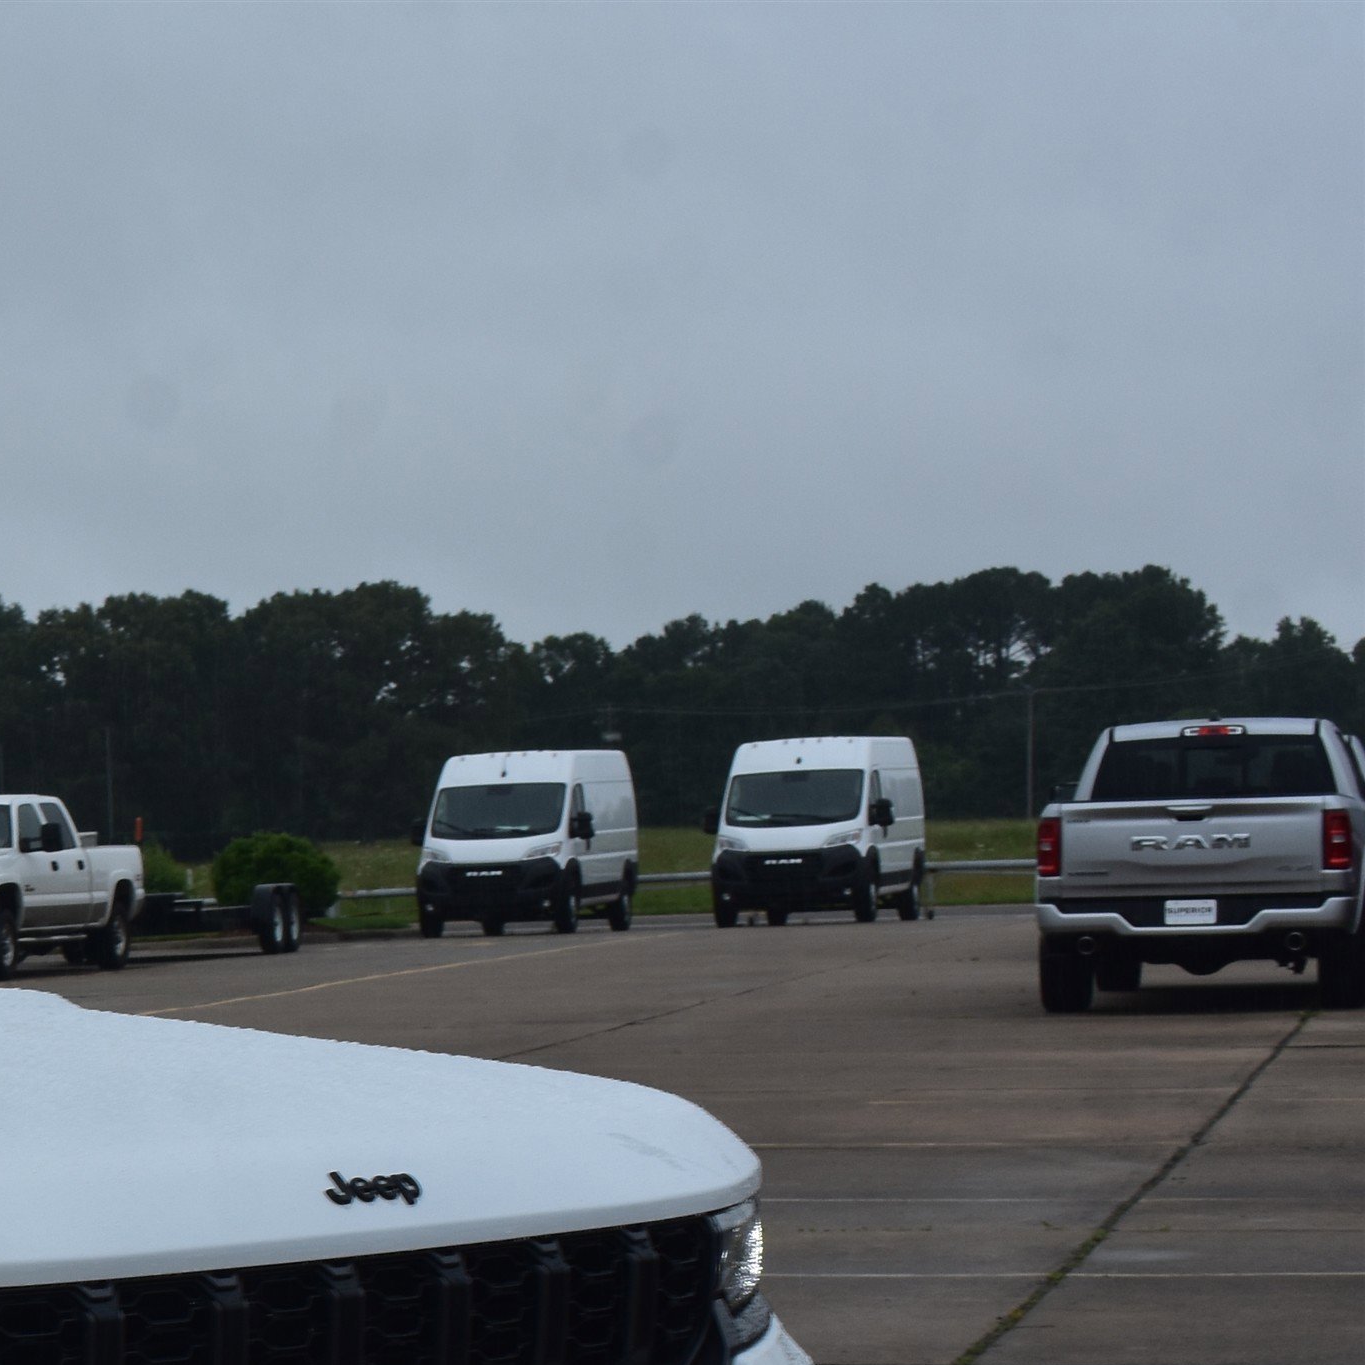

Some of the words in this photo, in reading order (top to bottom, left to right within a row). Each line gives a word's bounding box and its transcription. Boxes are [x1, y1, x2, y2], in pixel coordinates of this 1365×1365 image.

[1131, 833, 1250, 851] RAM
[1168, 906, 1212, 914] SUPERIOR
[325, 1171, 421, 1205] Jeep
